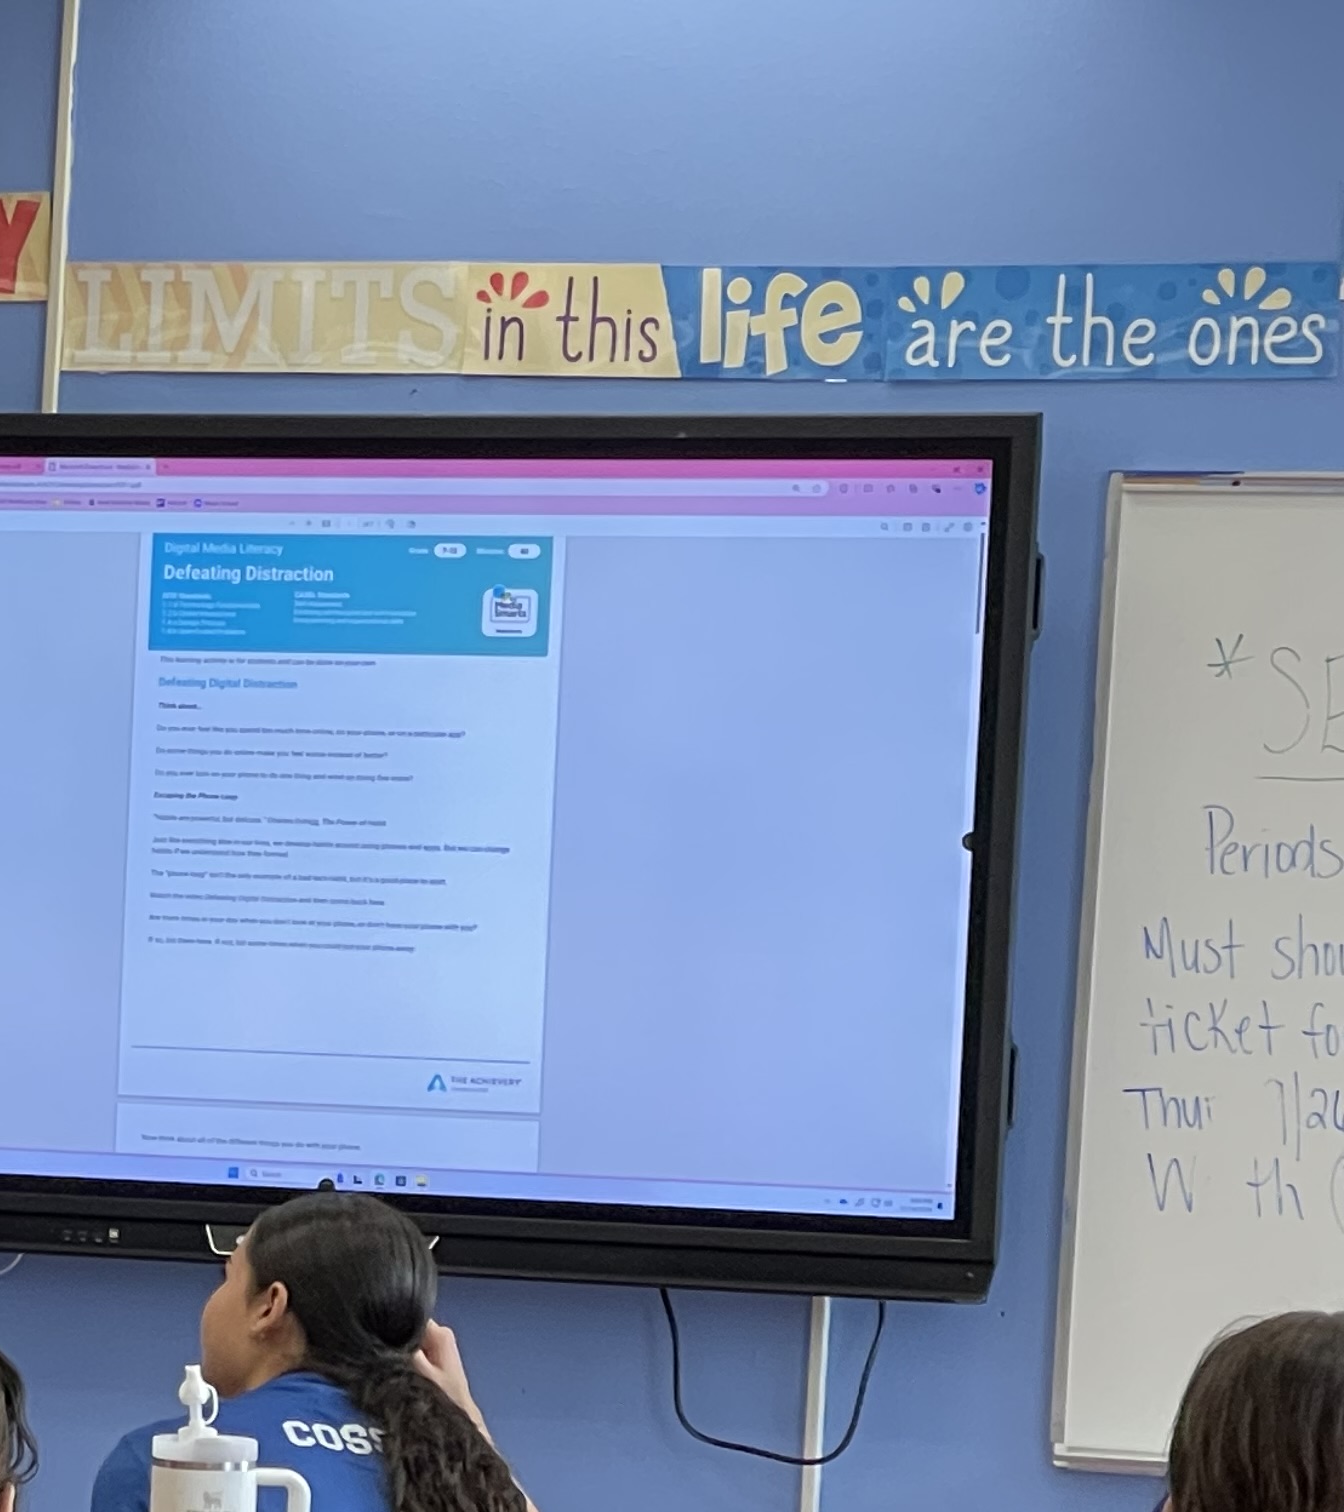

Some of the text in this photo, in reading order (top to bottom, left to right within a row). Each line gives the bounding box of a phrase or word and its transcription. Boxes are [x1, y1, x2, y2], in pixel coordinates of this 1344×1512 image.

[74, 267, 1326, 376] LIMITS in this life are the ones
[163, 564, 334, 585] Defeating Distraction
[1203, 804, 1344, 880] Periods
[1143, 913, 1344, 980] Must sho
[1140, 998, 1285, 1056] ticket
